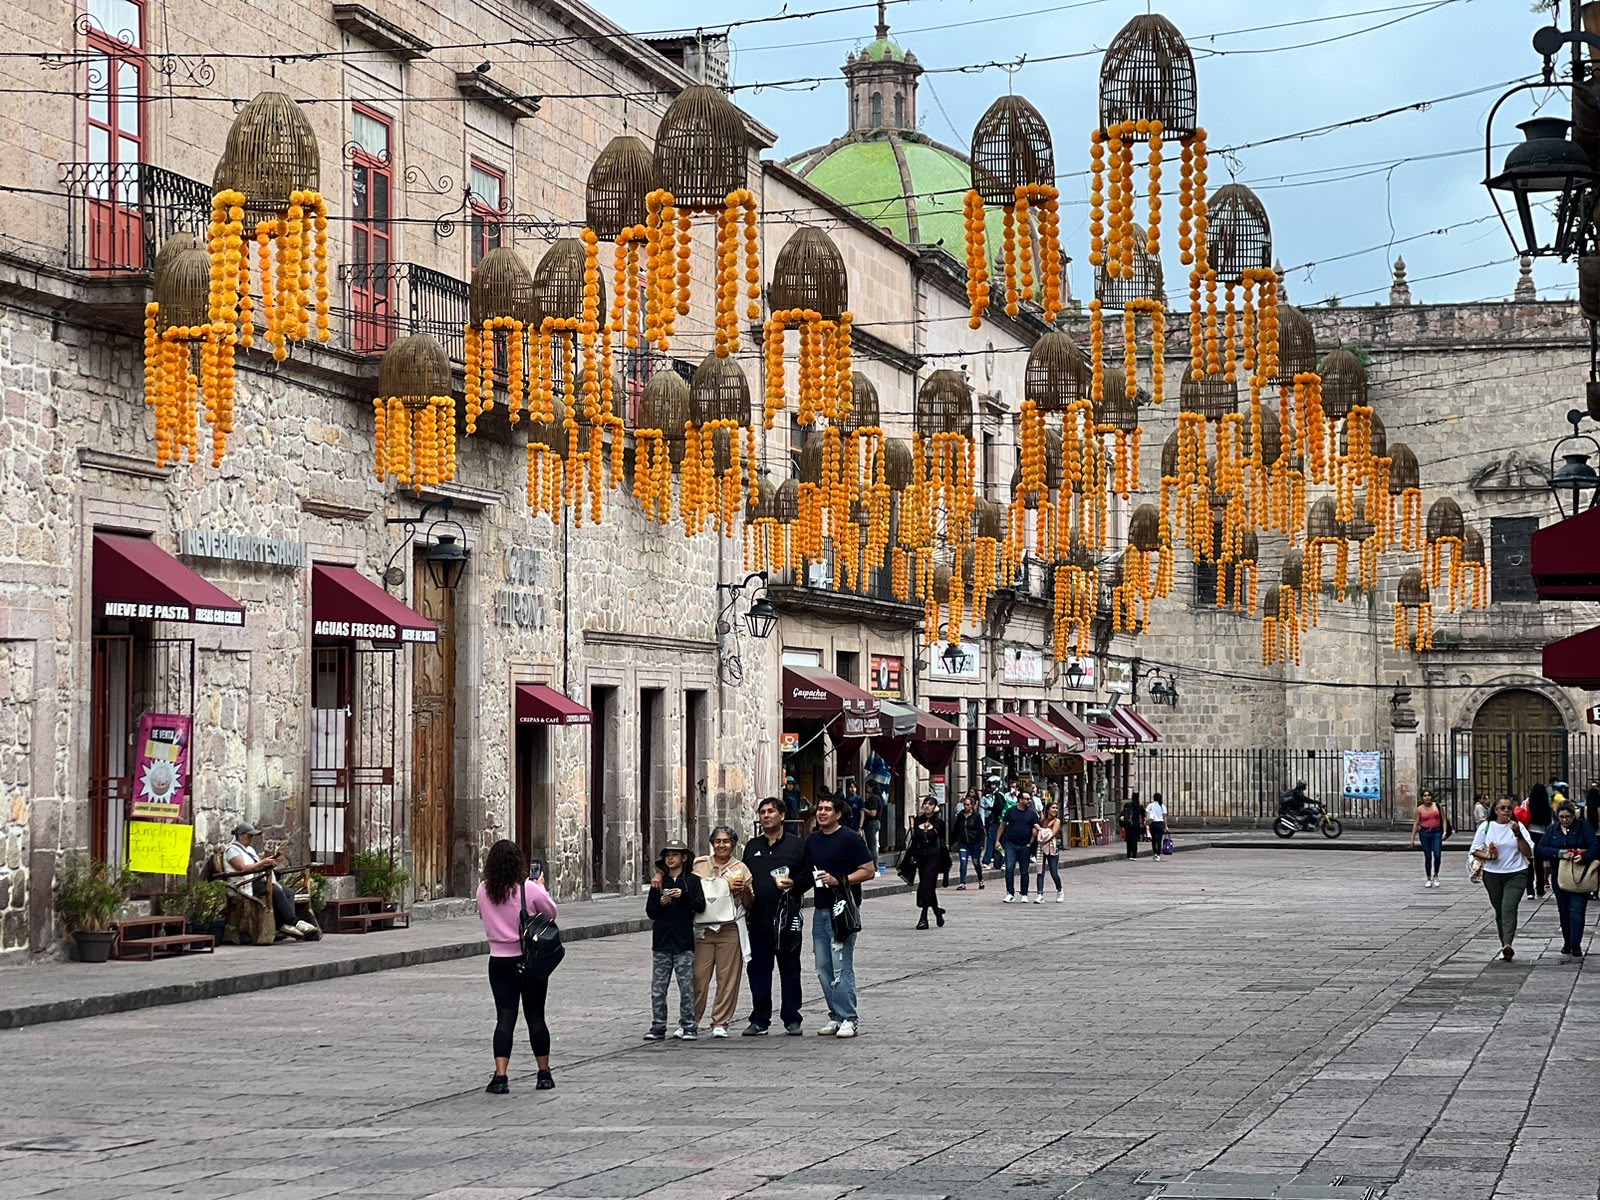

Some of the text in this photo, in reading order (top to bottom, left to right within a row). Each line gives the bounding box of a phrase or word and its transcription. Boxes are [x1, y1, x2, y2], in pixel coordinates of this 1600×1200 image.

[105, 602, 190, 620] NIEVE DE PASTA
[314, 621, 397, 639] AGUAS FRESCAS
[152, 729, 174, 740] DE VENTA
